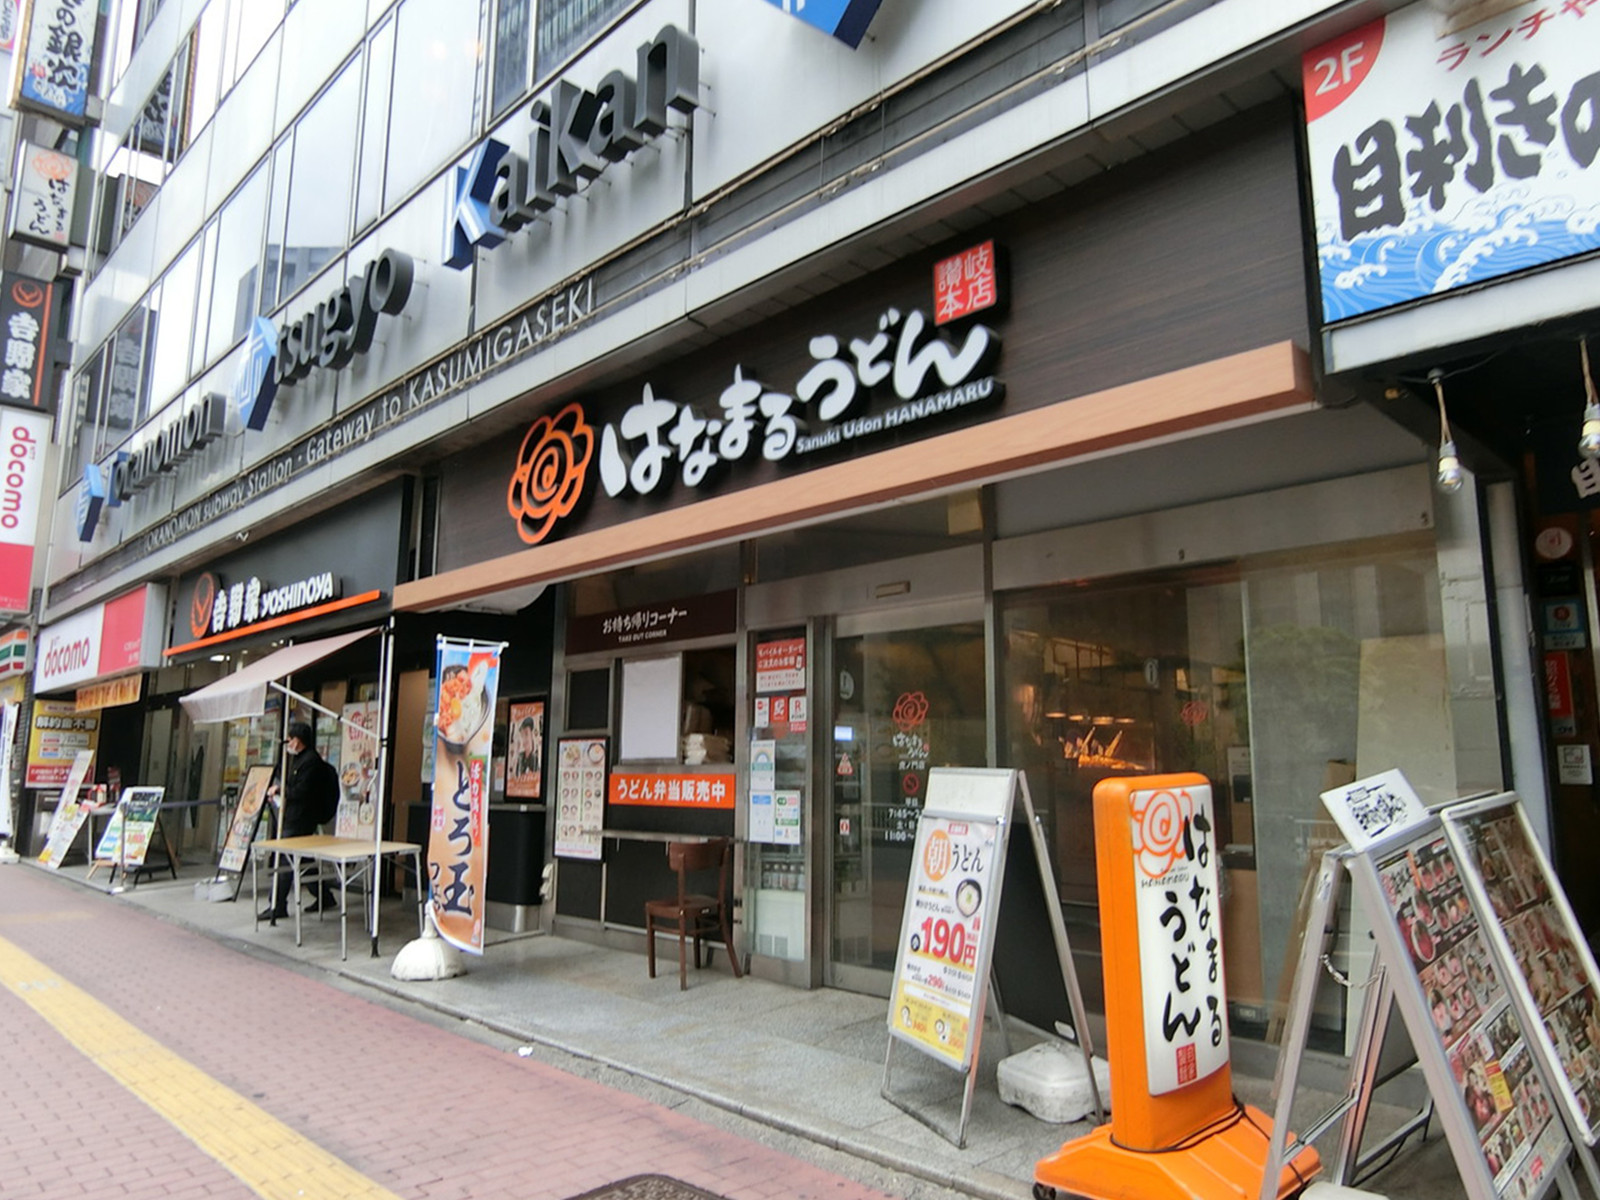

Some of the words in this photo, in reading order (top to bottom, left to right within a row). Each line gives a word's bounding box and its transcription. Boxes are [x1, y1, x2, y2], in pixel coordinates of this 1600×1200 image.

[1314, 41, 1364, 97] 2F
[441, 23, 700, 272] Kaikan
[1332, 62, 1600, 242] 目利きの
[28, 198, 51, 235] うどん
[305, 404, 376, 464] Gateway
[382, 395, 401, 420] to
[407, 276, 595, 410] KASUMIGASEKI
[795, 425, 841, 454] Sanuki
[842, 412, 884, 441] Udon
[883, 377, 994, 428] HANAMARU
[1, 426, 37, 529] docomo
[260, 570, 335, 618] YOSHINOYA
[602, 607, 688, 634] お持ち帰りコーナー
[43, 636, 91, 679] docomo
[617, 778, 727, 803] うどん弁当販売中
[951, 844, 984, 873] うどん
[1183, 803, 1224, 1048] はなまる
[1159, 890, 1202, 1042] うどん
